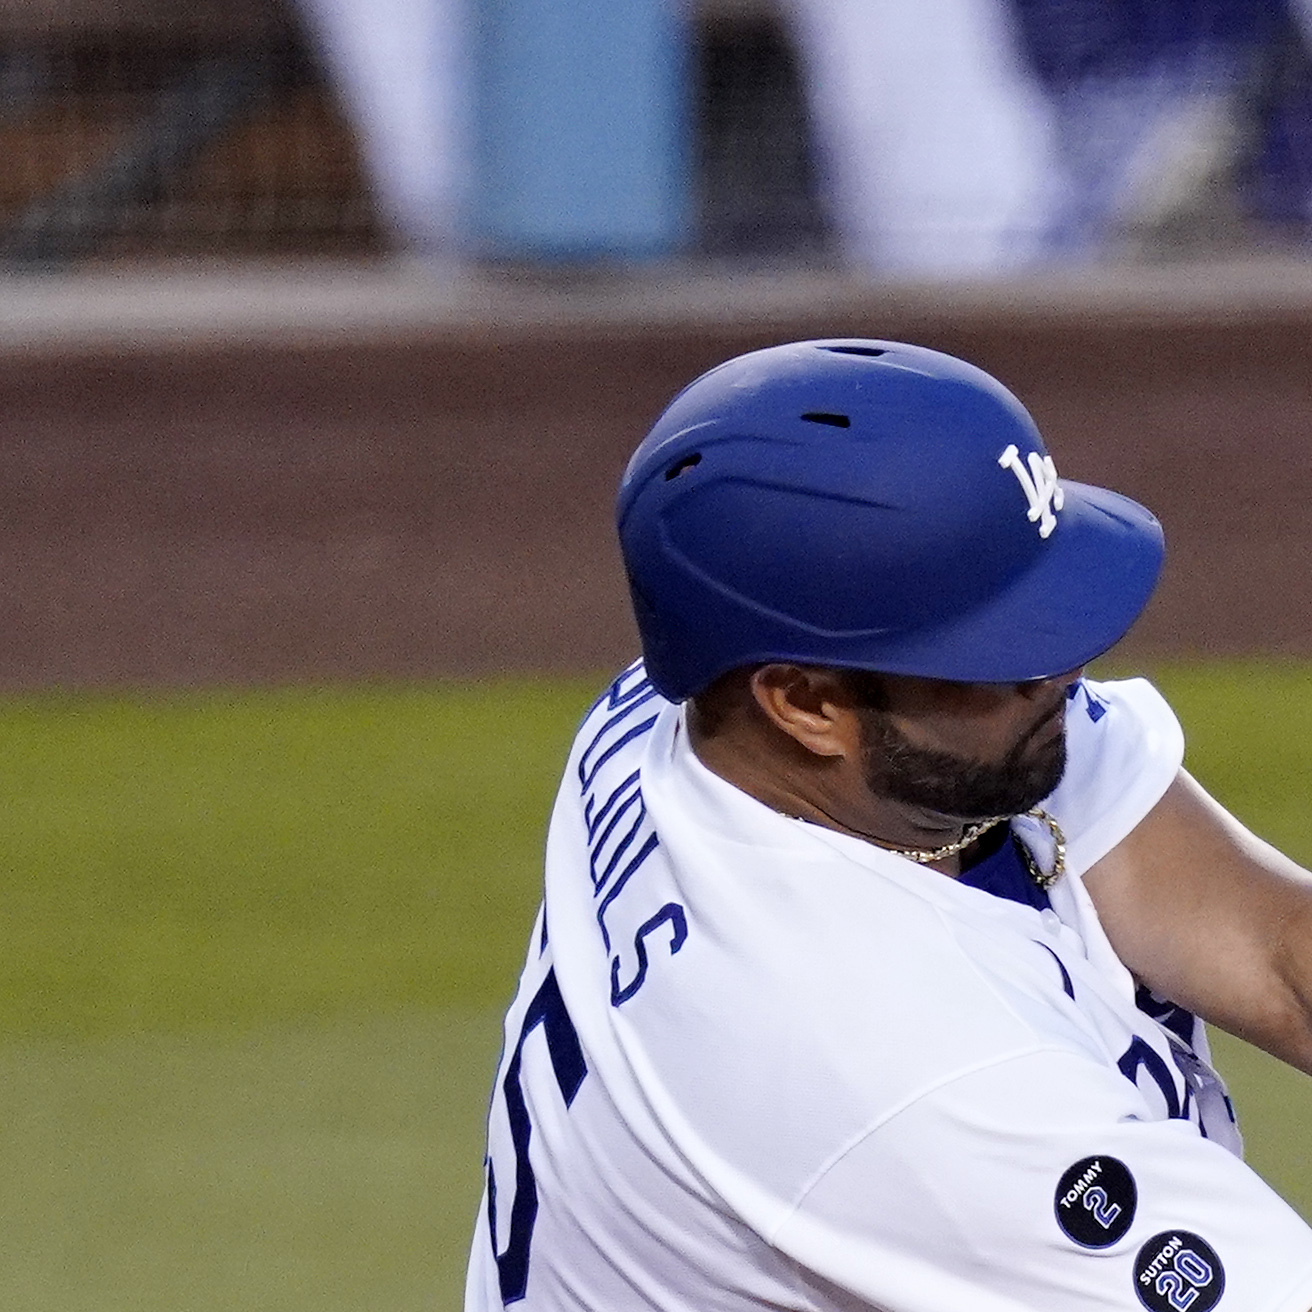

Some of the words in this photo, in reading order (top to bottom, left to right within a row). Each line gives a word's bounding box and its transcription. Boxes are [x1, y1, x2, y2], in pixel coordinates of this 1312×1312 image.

[1060, 1161, 1102, 1208] TOMMY
[1083, 1186, 1122, 1229] 2
[1140, 1236, 1183, 1285] SUTTON
